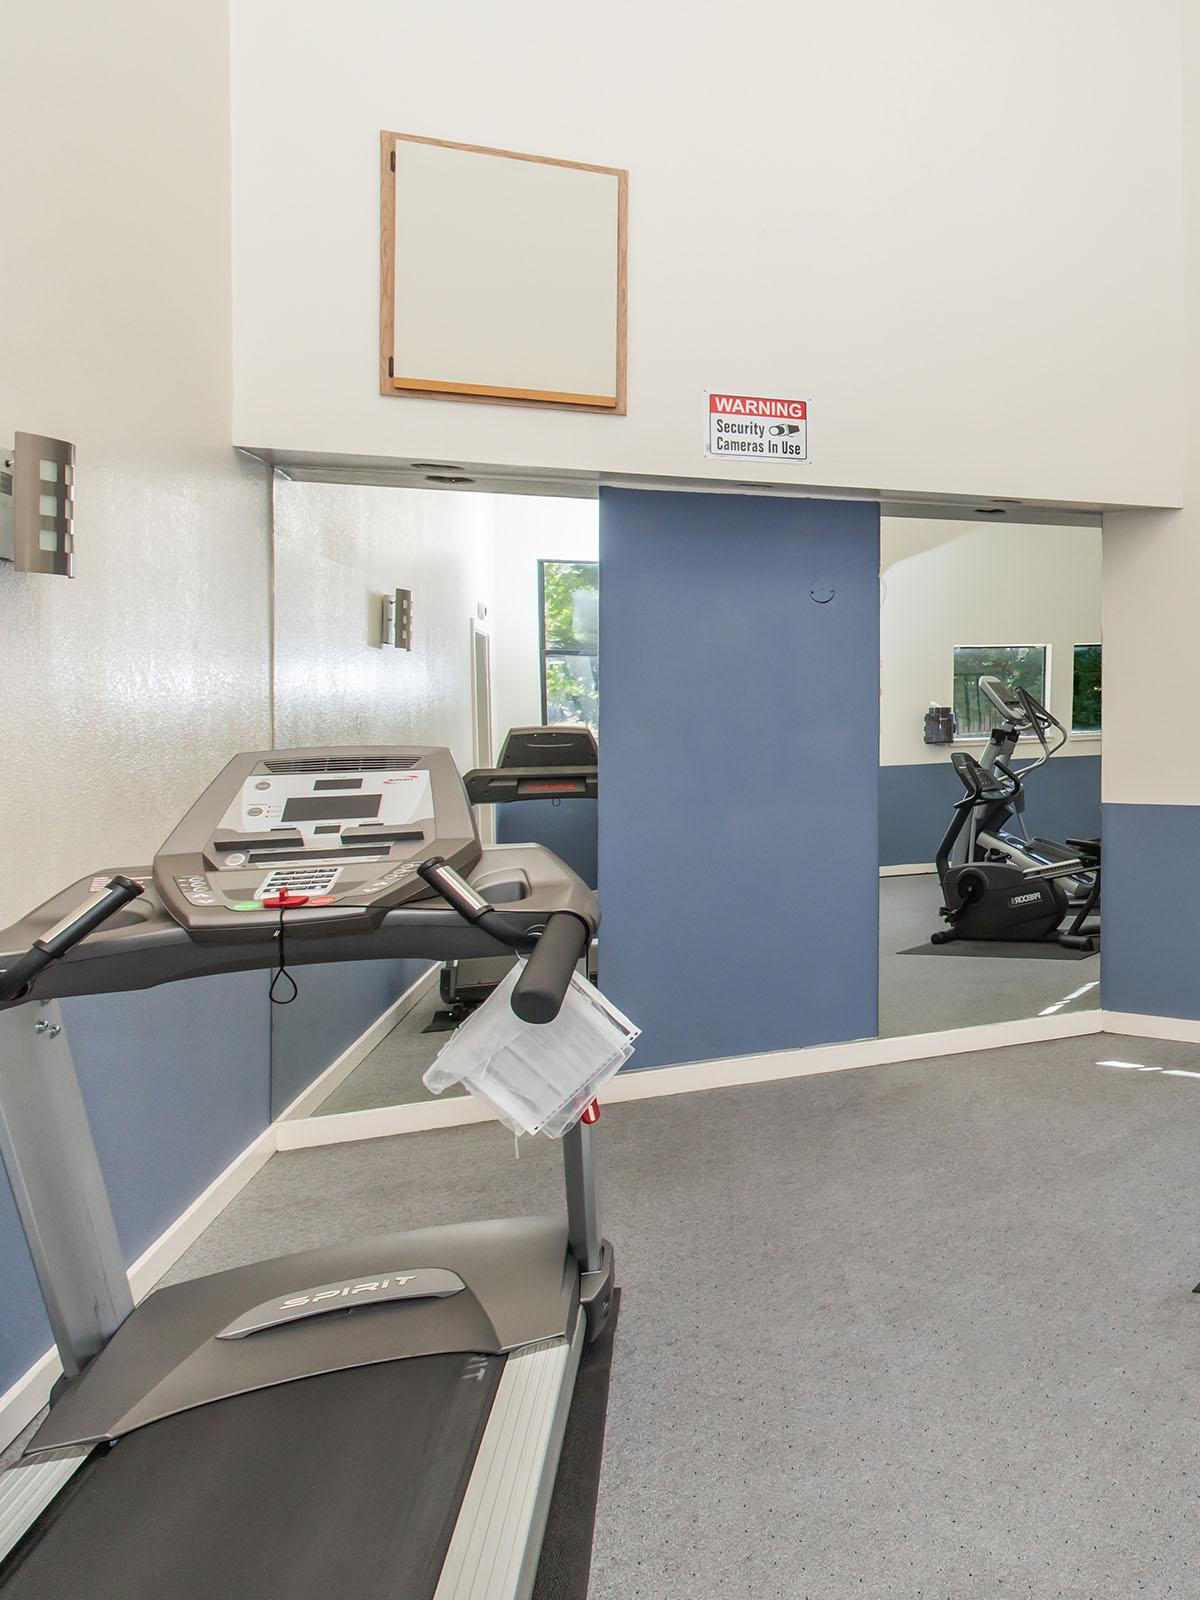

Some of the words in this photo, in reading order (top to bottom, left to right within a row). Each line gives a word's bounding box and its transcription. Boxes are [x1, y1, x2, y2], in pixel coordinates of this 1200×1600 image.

[715, 397, 802, 418] WARNING
[716, 419, 765, 438] Security
[717, 437, 764, 453] Cameras
[768, 440, 778, 453] In
[782, 441, 801, 455] Use
[279, 1275, 417, 1310] SPIRIT
